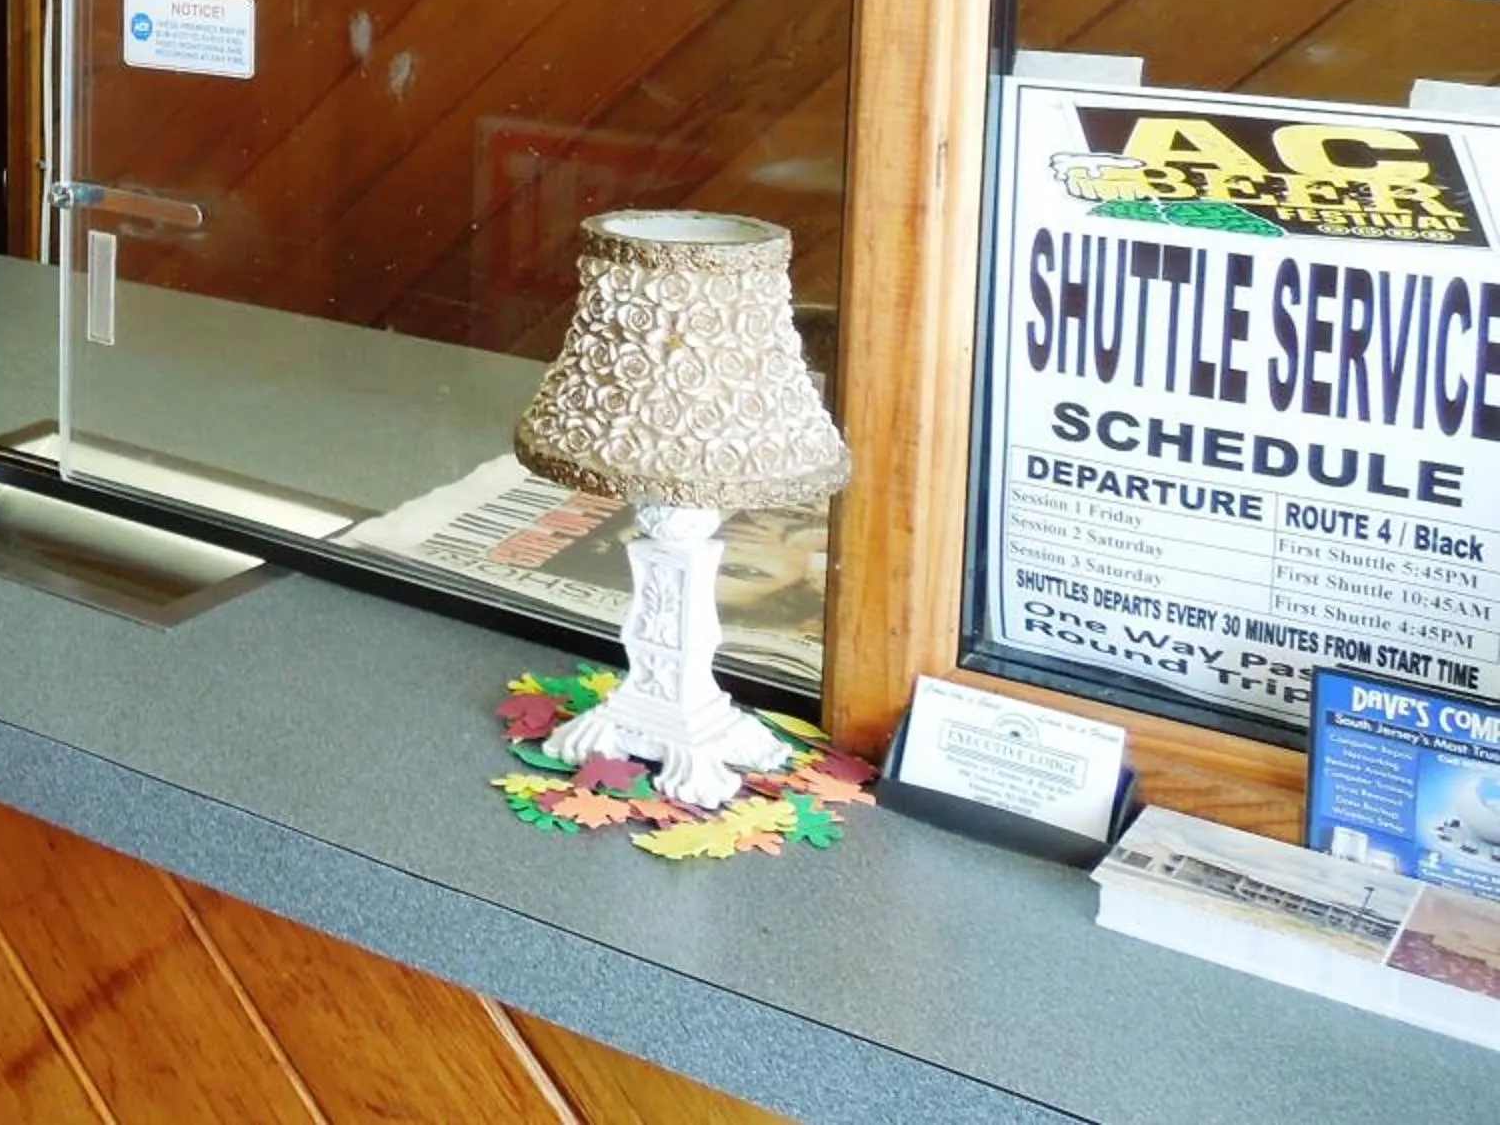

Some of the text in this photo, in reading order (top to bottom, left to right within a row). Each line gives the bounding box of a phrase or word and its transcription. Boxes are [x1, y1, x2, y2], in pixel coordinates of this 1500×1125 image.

[1122, 117, 1430, 178] AC
[1142, 167, 1465, 218] BEER
[1275, 206, 1472, 232] FESTIVAL
[1026, 227, 1500, 441] SHUTTLE SERVICE
[1052, 401, 1465, 509] SCHEDULE
[1010, 487, 1145, 530] Session 1 Friday
[1027, 454, 1264, 522] DEPARTURE
[1009, 511, 1165, 559] Session 2 Saturday
[1285, 502, 1370, 540] ROUTE
[1377, 518, 1393, 545] 4
[1414, 524, 1485, 563] Black
[1009, 539, 1164, 588] Session 3 Saturday
[1278, 537, 1479, 590] First Shuttle 5:45PM
[1274, 593, 1475, 651] First Shuttle 4:45PM
[1276, 564, 1493, 622] First Shuttle 10:45AM
[1016, 568, 1480, 691] SHUTTLES DEPARTS EVERY 30 MINUTES FROM START TIME
[1024, 600, 1108, 636] One
[1123, 624, 1225, 665] Way
[1024, 618, 1311, 705] Round Trip
[1334, 713, 1470, 756] South Jersey's Most
[1352, 685, 1431, 729] DAVE'S
[948, 729, 1028, 762] EXECUTIVE
